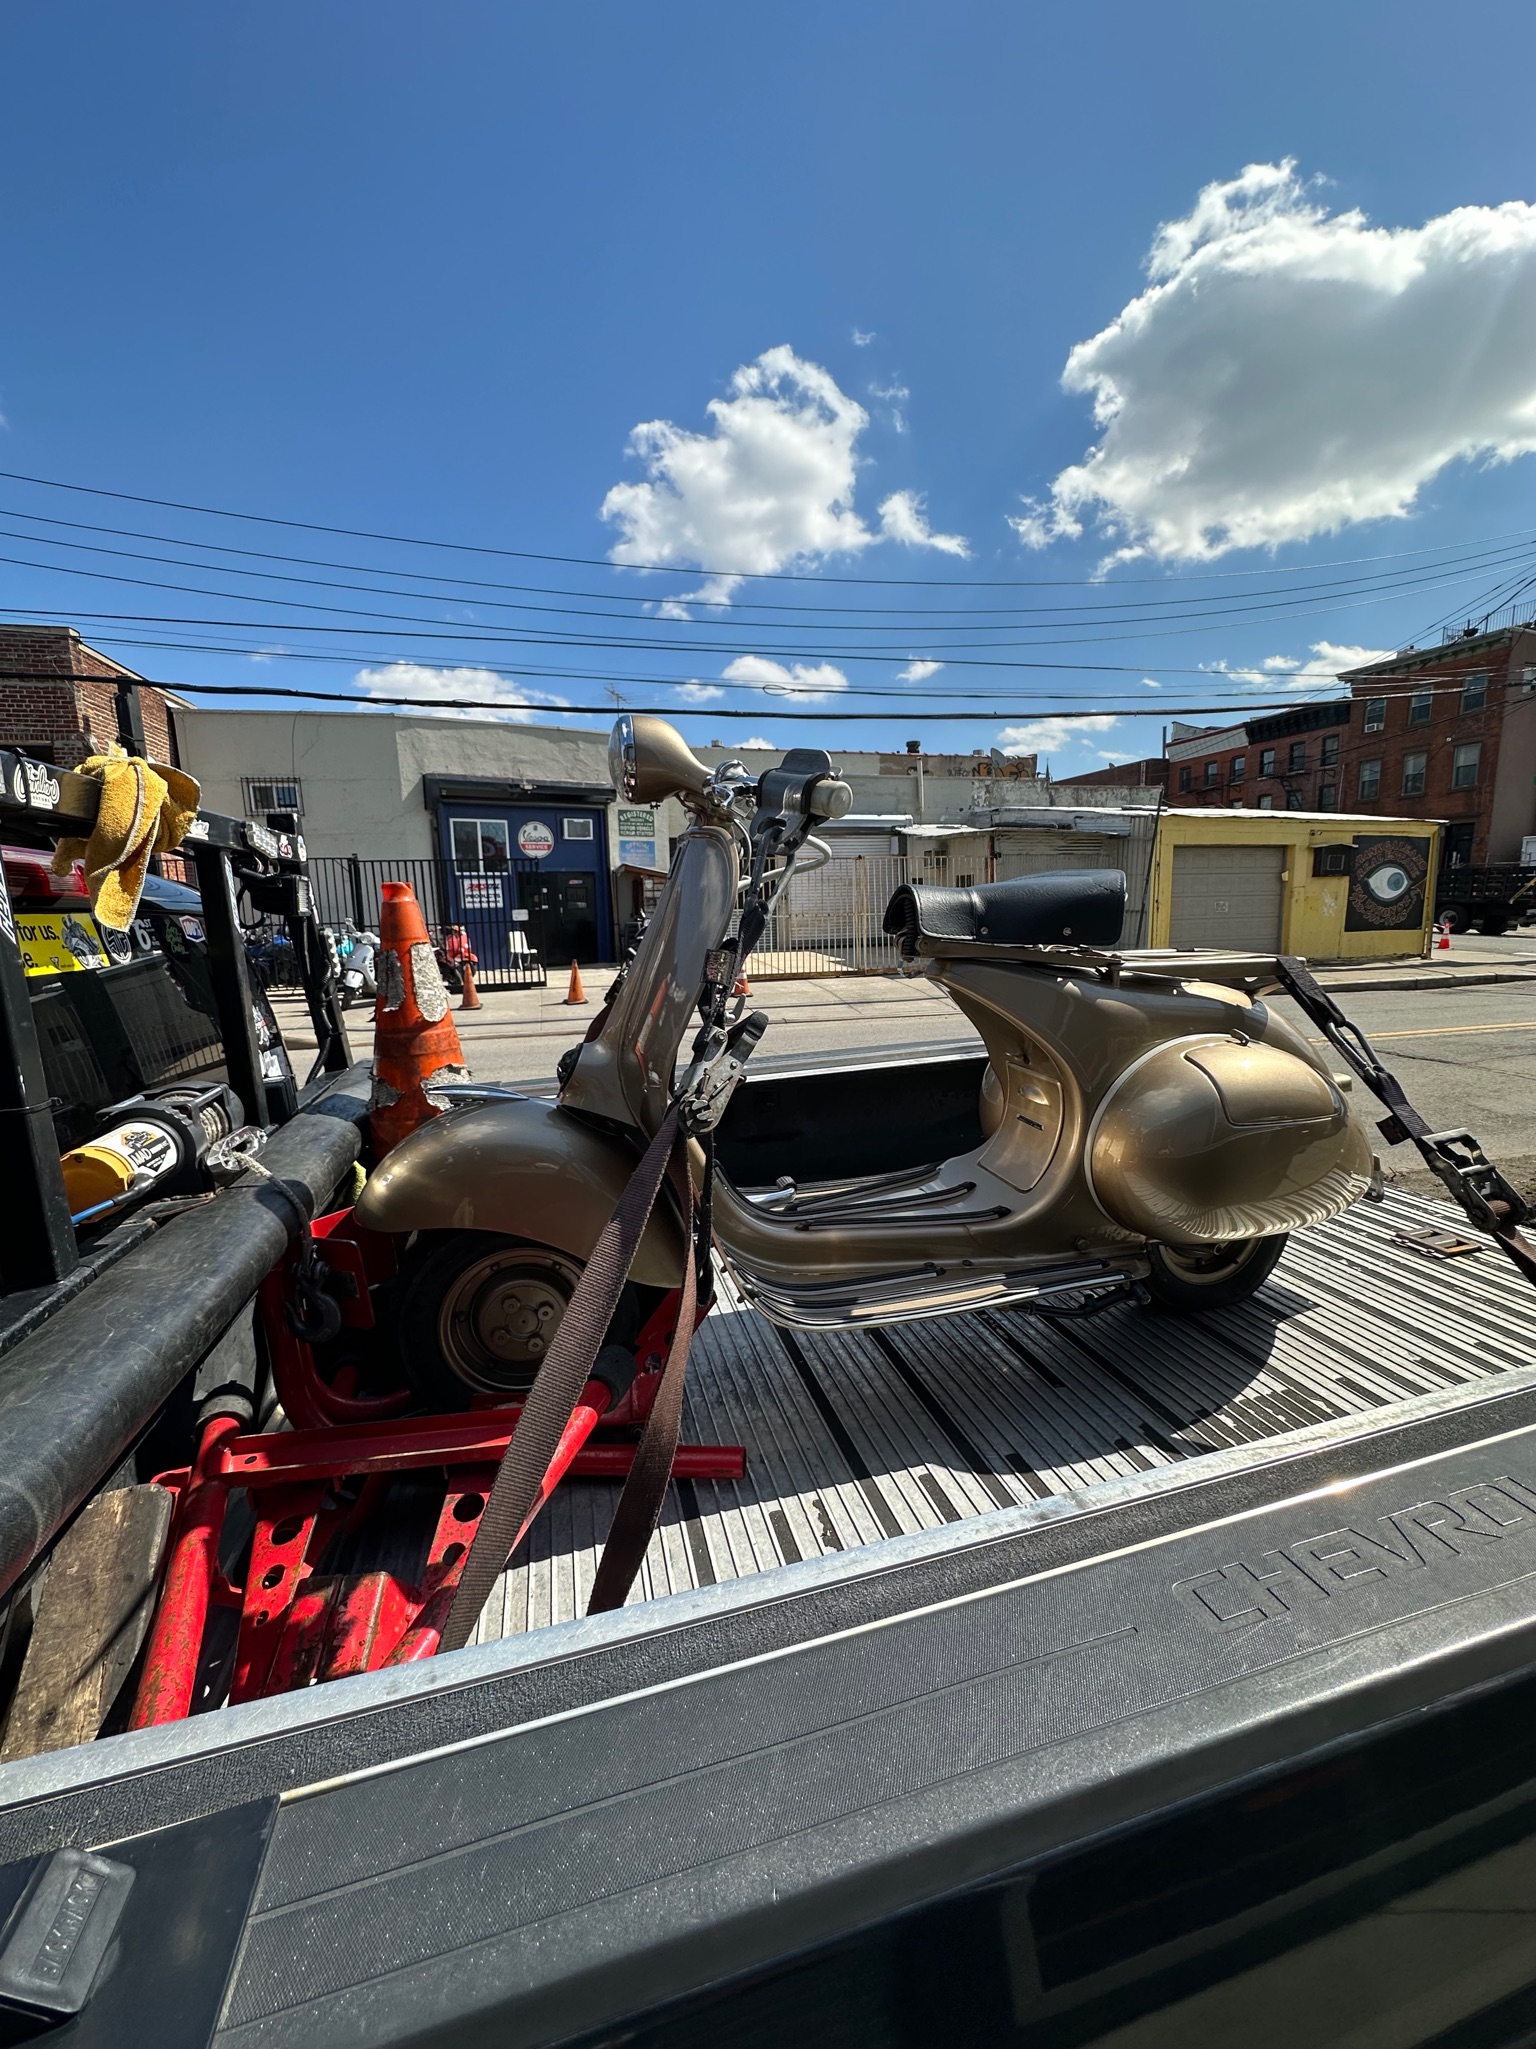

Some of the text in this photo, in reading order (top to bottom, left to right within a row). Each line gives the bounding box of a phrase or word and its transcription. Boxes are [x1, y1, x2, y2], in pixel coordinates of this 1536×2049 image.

[619, 811, 654, 822] REGISTERED
[1356, 850, 1420, 881] REAL ESTATE
[15, 920, 60, 942] for us.
[130, 1147, 153, 1166] MAD
